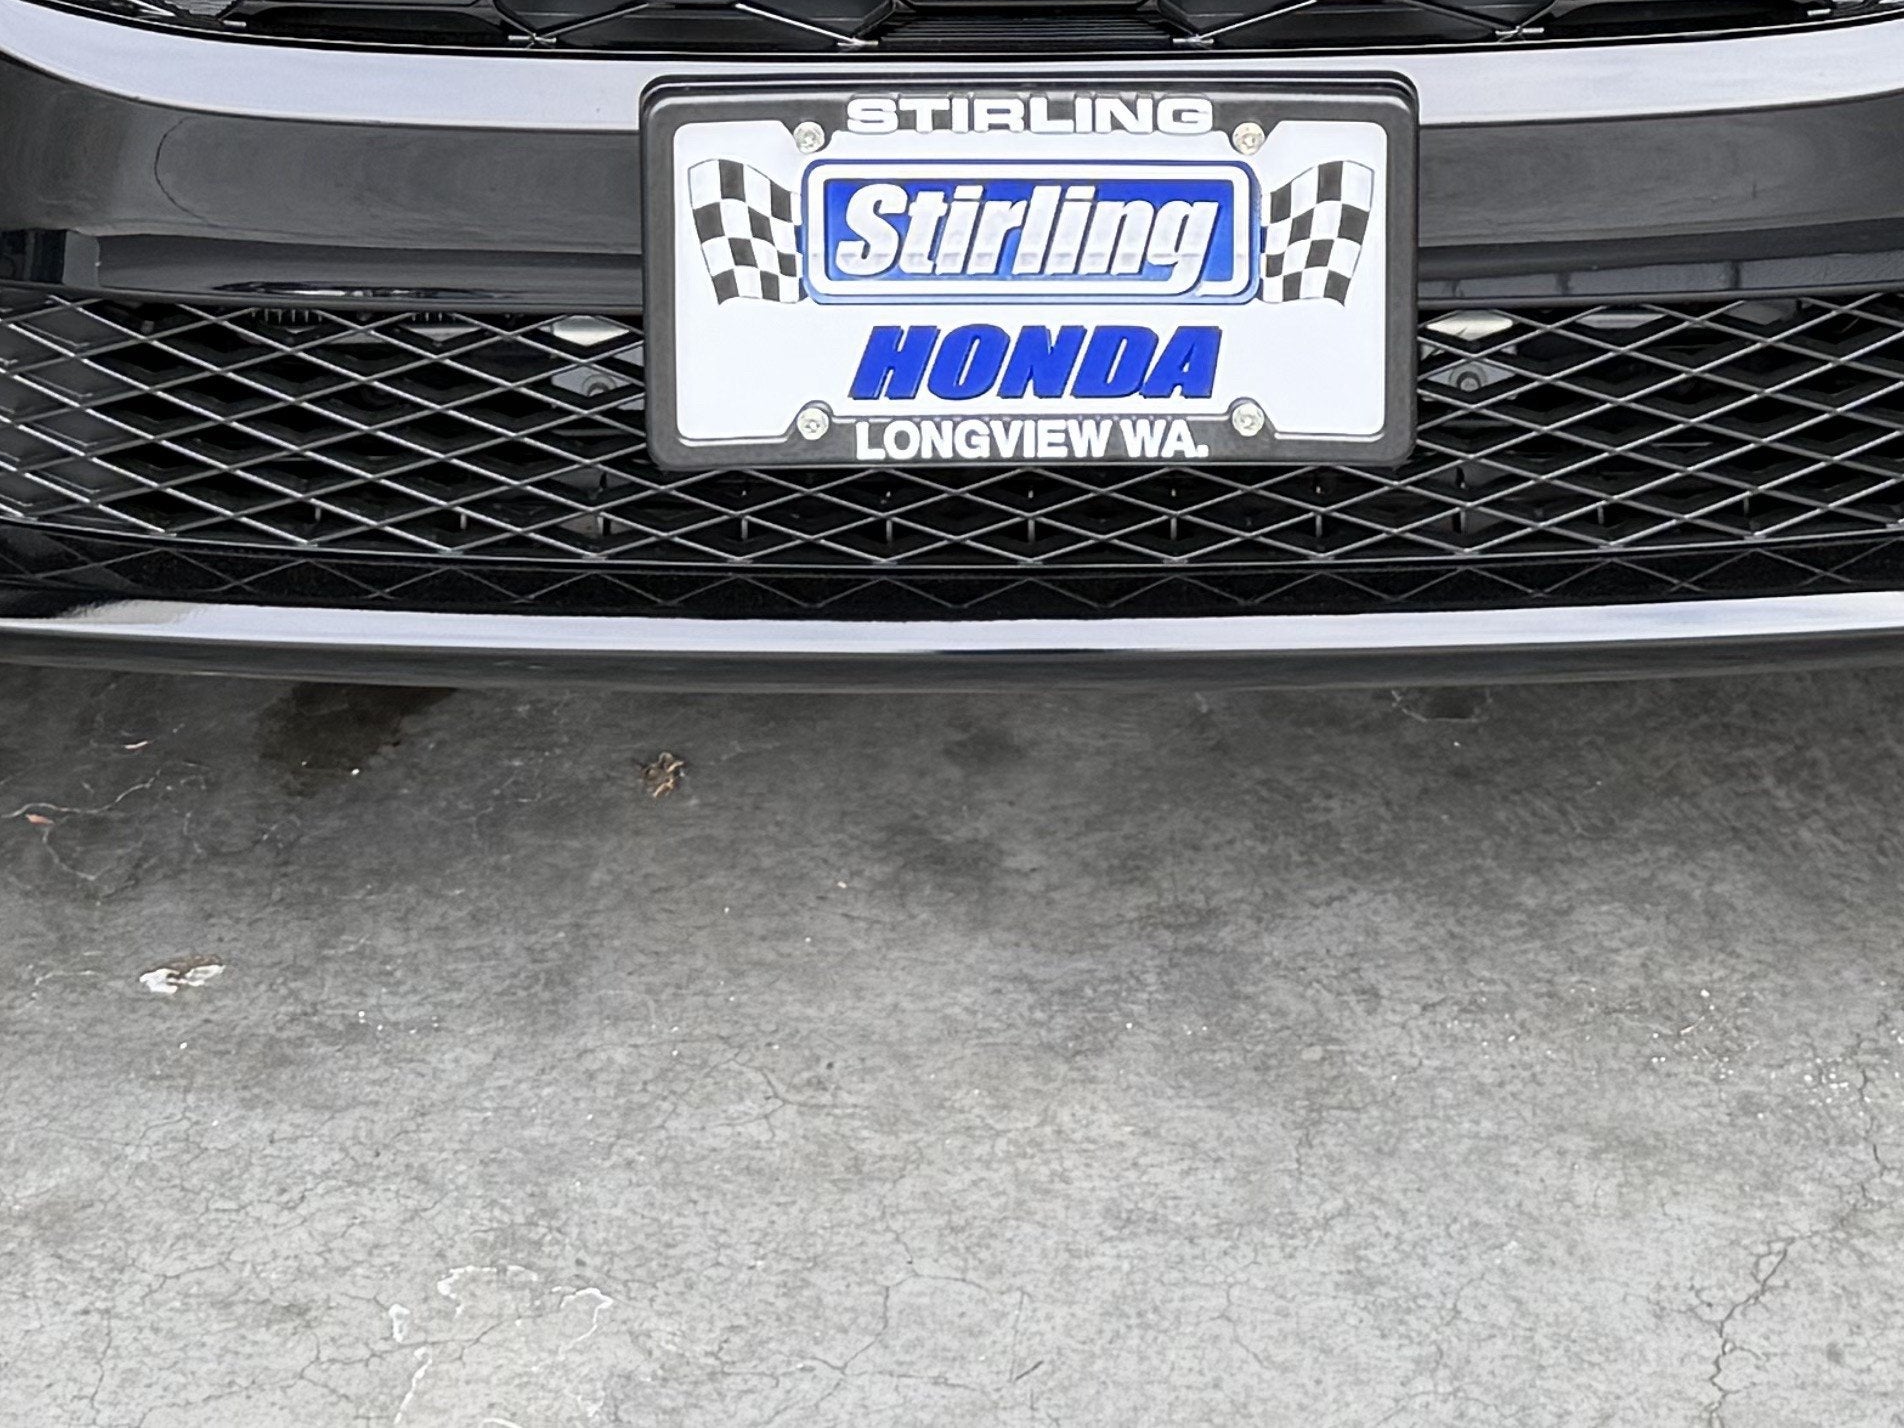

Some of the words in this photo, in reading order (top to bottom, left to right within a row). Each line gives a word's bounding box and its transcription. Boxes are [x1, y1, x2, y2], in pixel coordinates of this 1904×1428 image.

[846, 96, 1214, 134] STIRLING
[835, 182, 1220, 295] Stirling
[848, 323, 1223, 400] HONDA
[855, 419, 1113, 460] LONGVIEW
[1118, 419, 1209, 459] WA.
